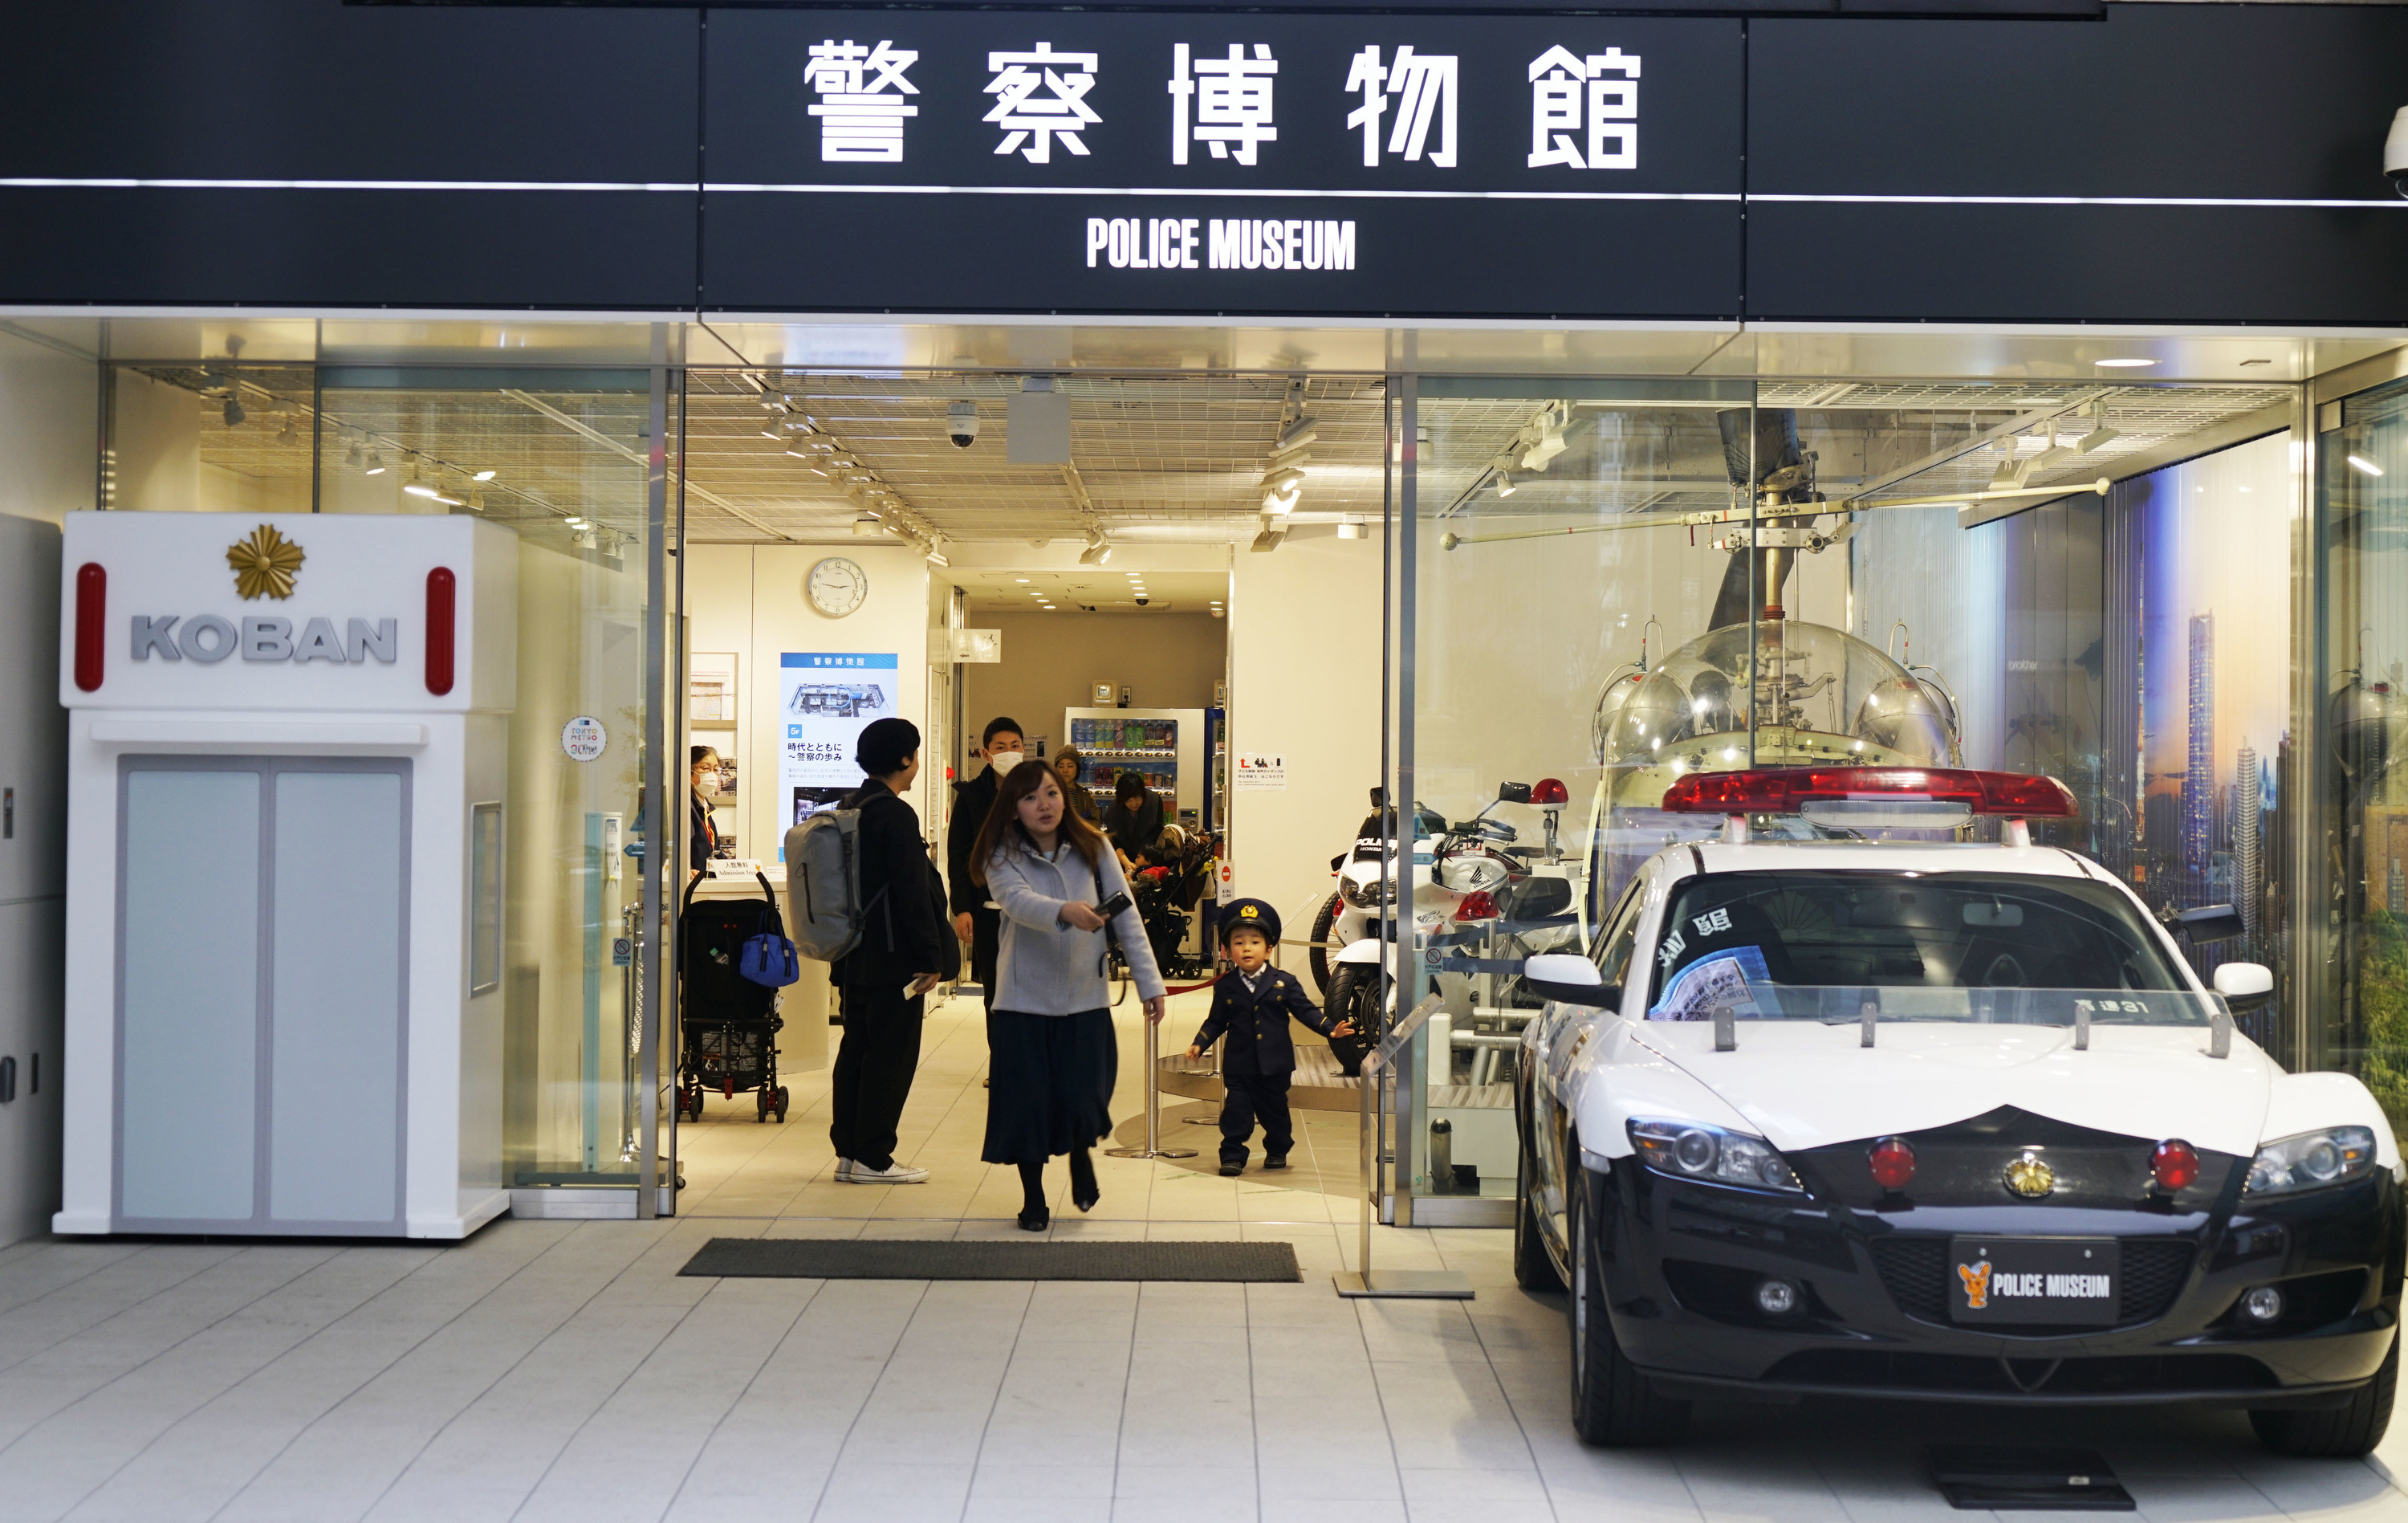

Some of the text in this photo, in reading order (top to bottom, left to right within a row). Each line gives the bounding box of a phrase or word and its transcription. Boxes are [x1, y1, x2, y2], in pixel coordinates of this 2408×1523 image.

[804, 39, 1641, 170] 警察博物館
[1087, 217, 1357, 271] POLICE MUSEUM
[131, 614, 397, 664] KOBAN
[813, 657, 865, 666] 警察博物館
[790, 727, 800, 735] 5F
[787, 743, 843, 752] 時代とともに
[1992, 1273, 2110, 1297] POLICE MUSEUM
